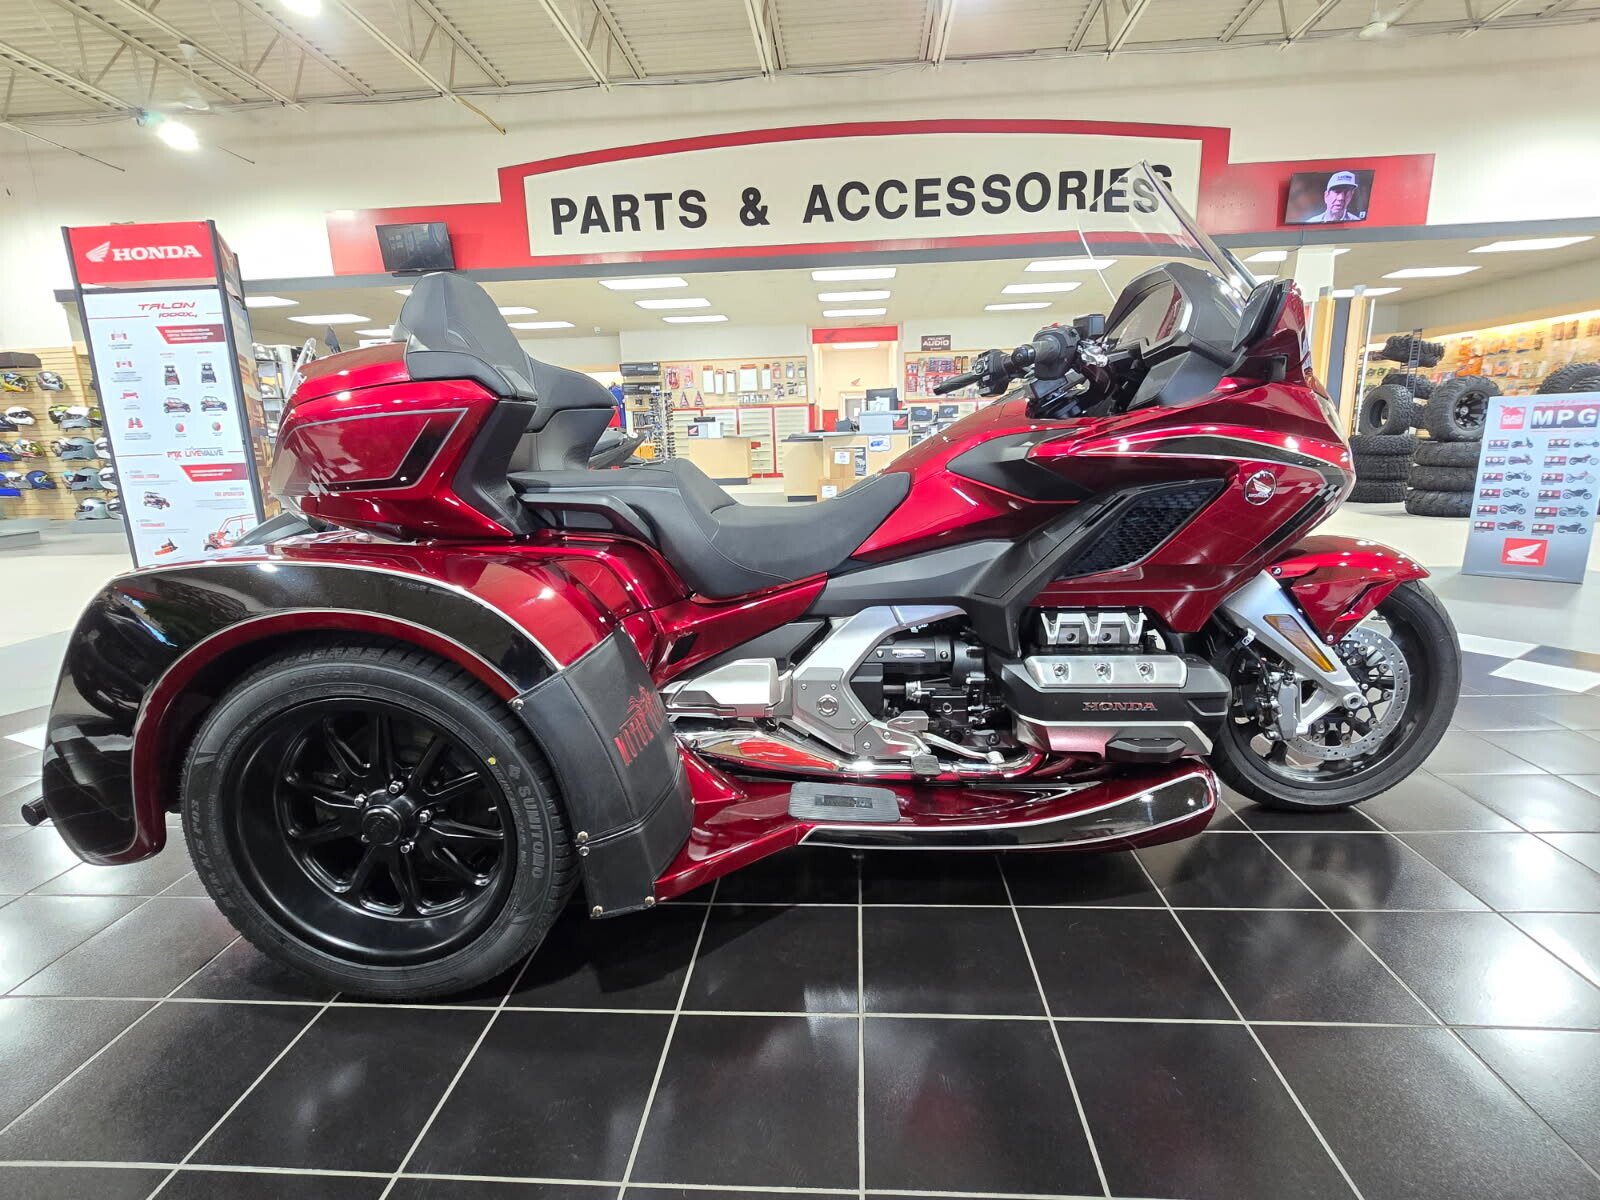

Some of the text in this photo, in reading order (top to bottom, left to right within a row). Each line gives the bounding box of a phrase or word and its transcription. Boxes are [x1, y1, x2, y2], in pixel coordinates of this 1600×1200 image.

[551, 163, 1173, 236] PARTS & ACCESSORIES
[112, 245, 202, 261] HONDA
[138, 302, 196, 310] TALON
[1533, 409, 1597, 425] MPG
[1082, 702, 1158, 711] HONDA
